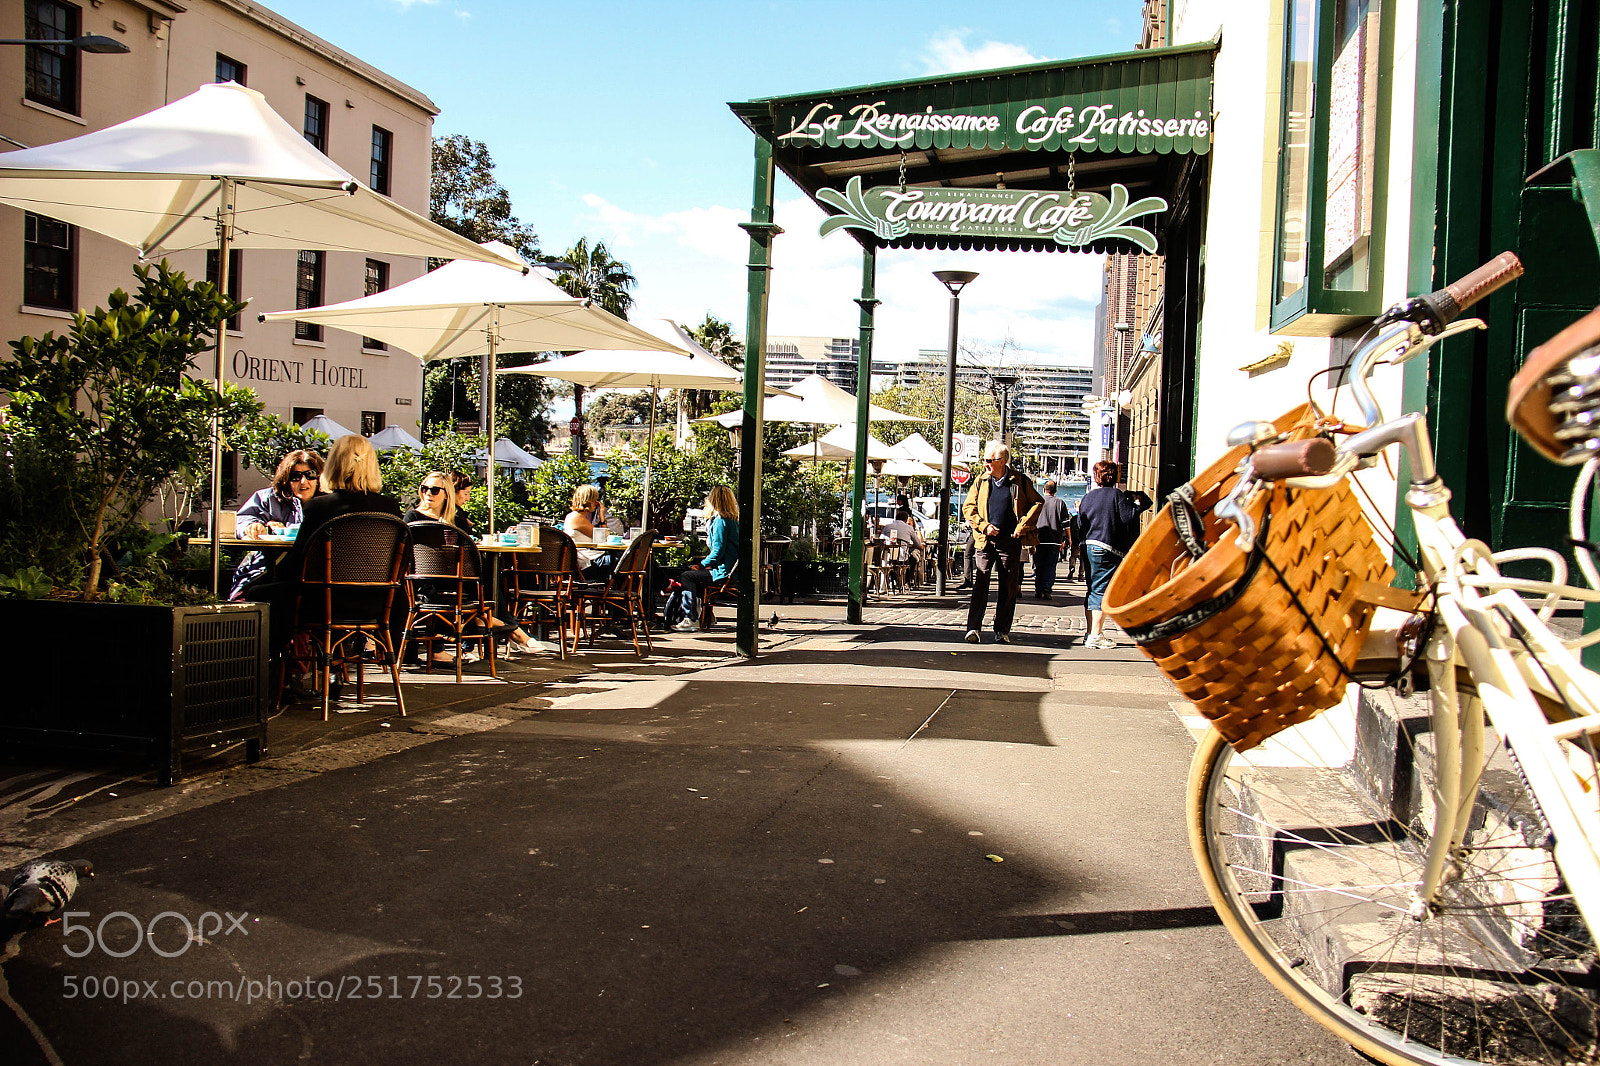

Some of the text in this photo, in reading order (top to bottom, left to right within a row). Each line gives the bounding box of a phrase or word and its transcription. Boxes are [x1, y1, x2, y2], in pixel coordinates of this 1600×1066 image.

[777, 101, 1209, 143] La Renaissance Café Patisserie
[880, 190, 1093, 233] Courtyard Café
[570, 422, 580, 431] STOP
